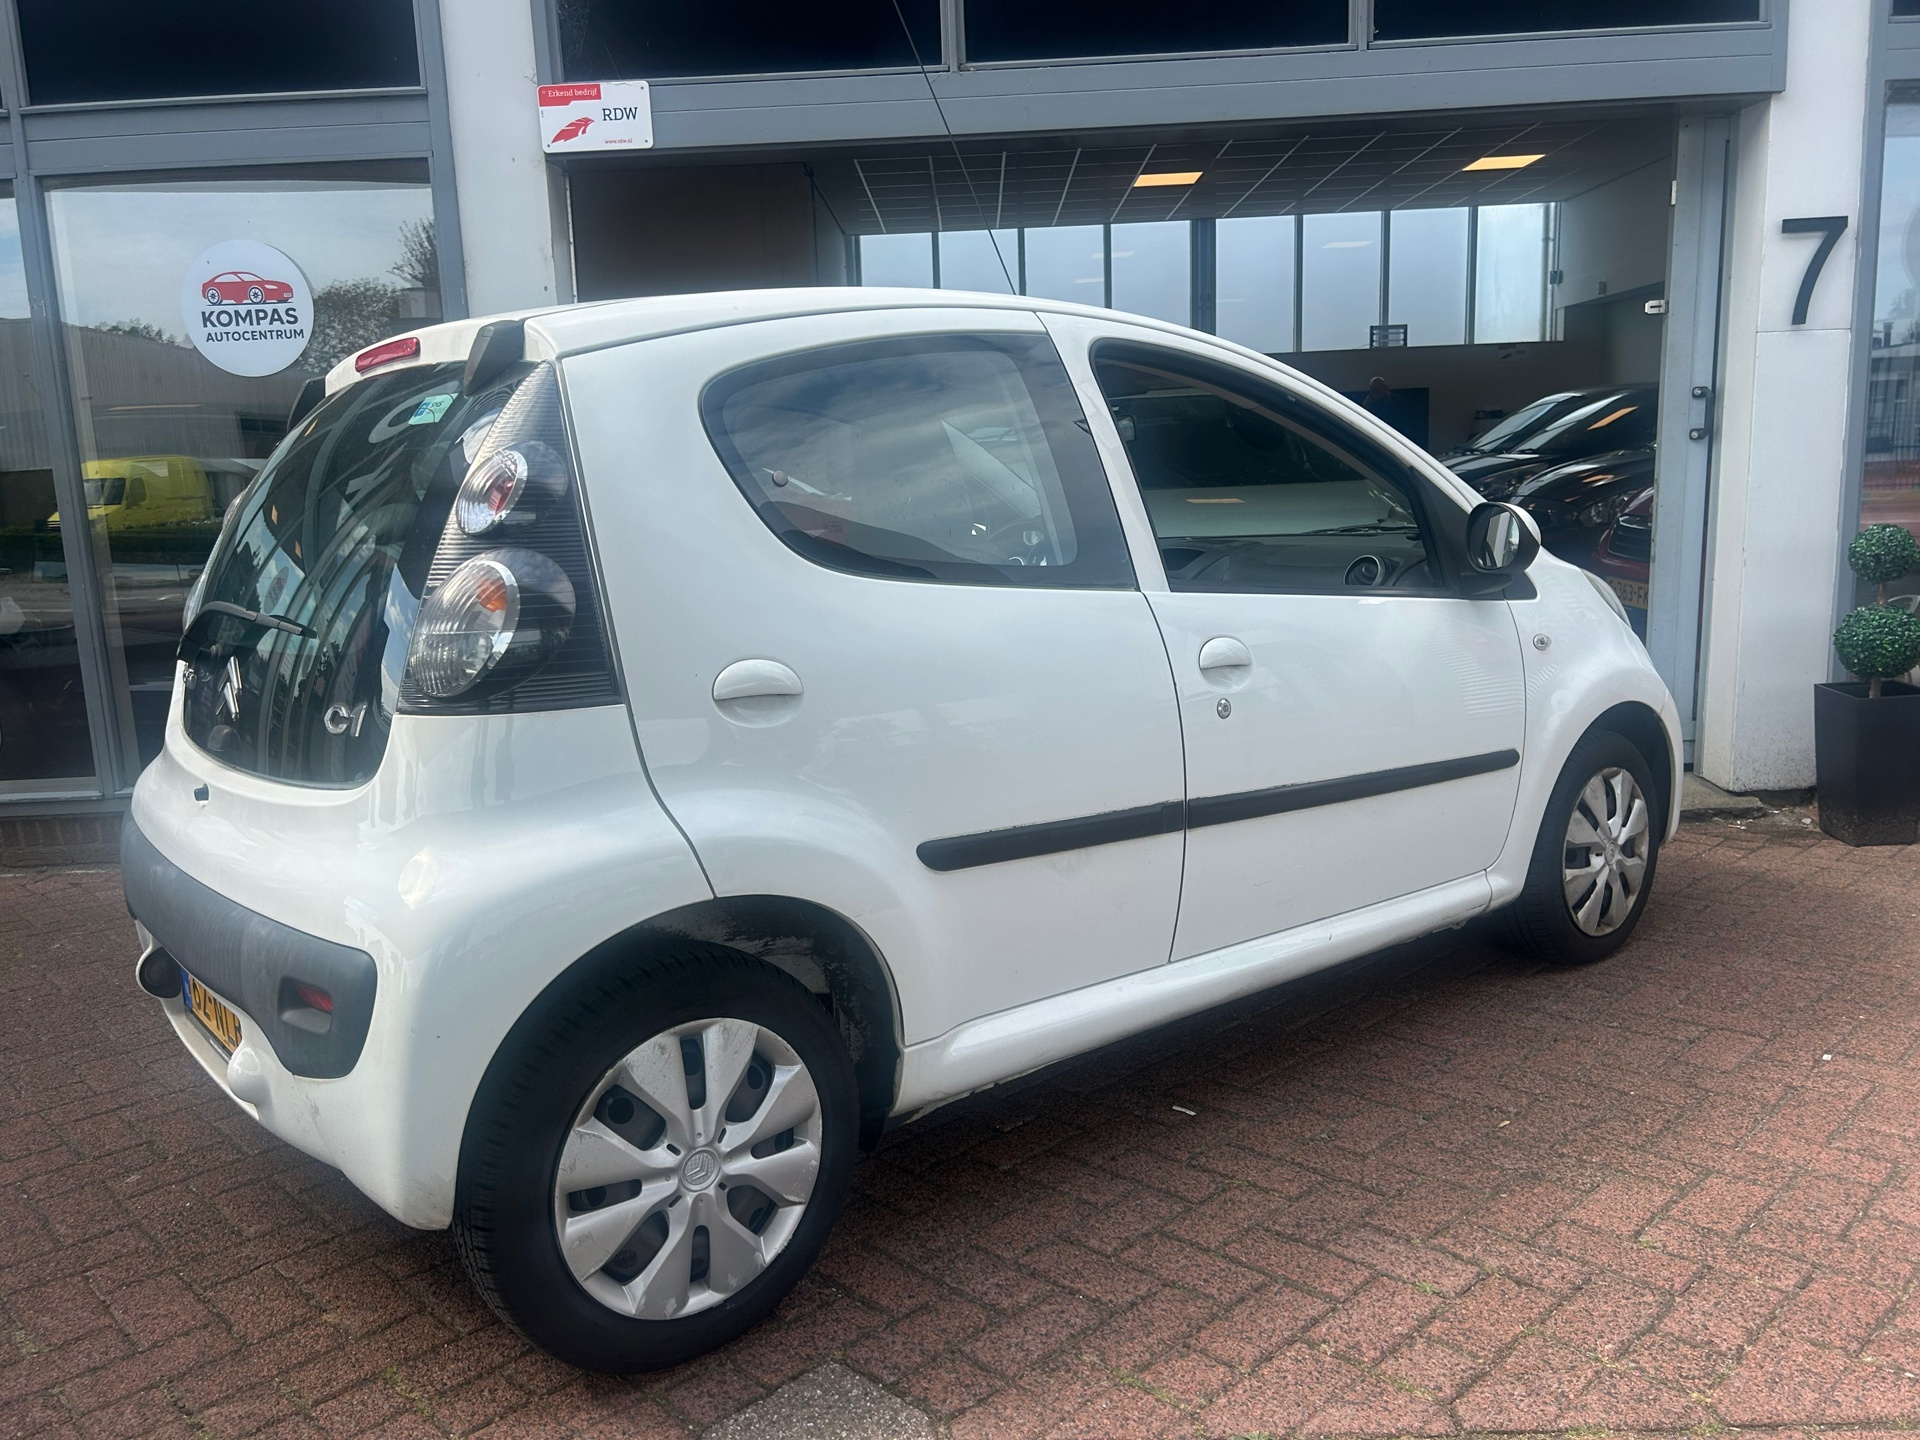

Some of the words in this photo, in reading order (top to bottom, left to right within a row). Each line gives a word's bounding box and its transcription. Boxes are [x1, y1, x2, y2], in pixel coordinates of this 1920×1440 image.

[548, 89, 573, 97] Erkend
[574, 88, 597, 96] bedrijf
[602, 107, 638, 121] RDW
[1782, 216, 1848, 325] 7
[201, 308, 299, 328] KOMPAS
[206, 329, 304, 342] AUTOCENTRUM
[324, 703, 368, 737] C1
